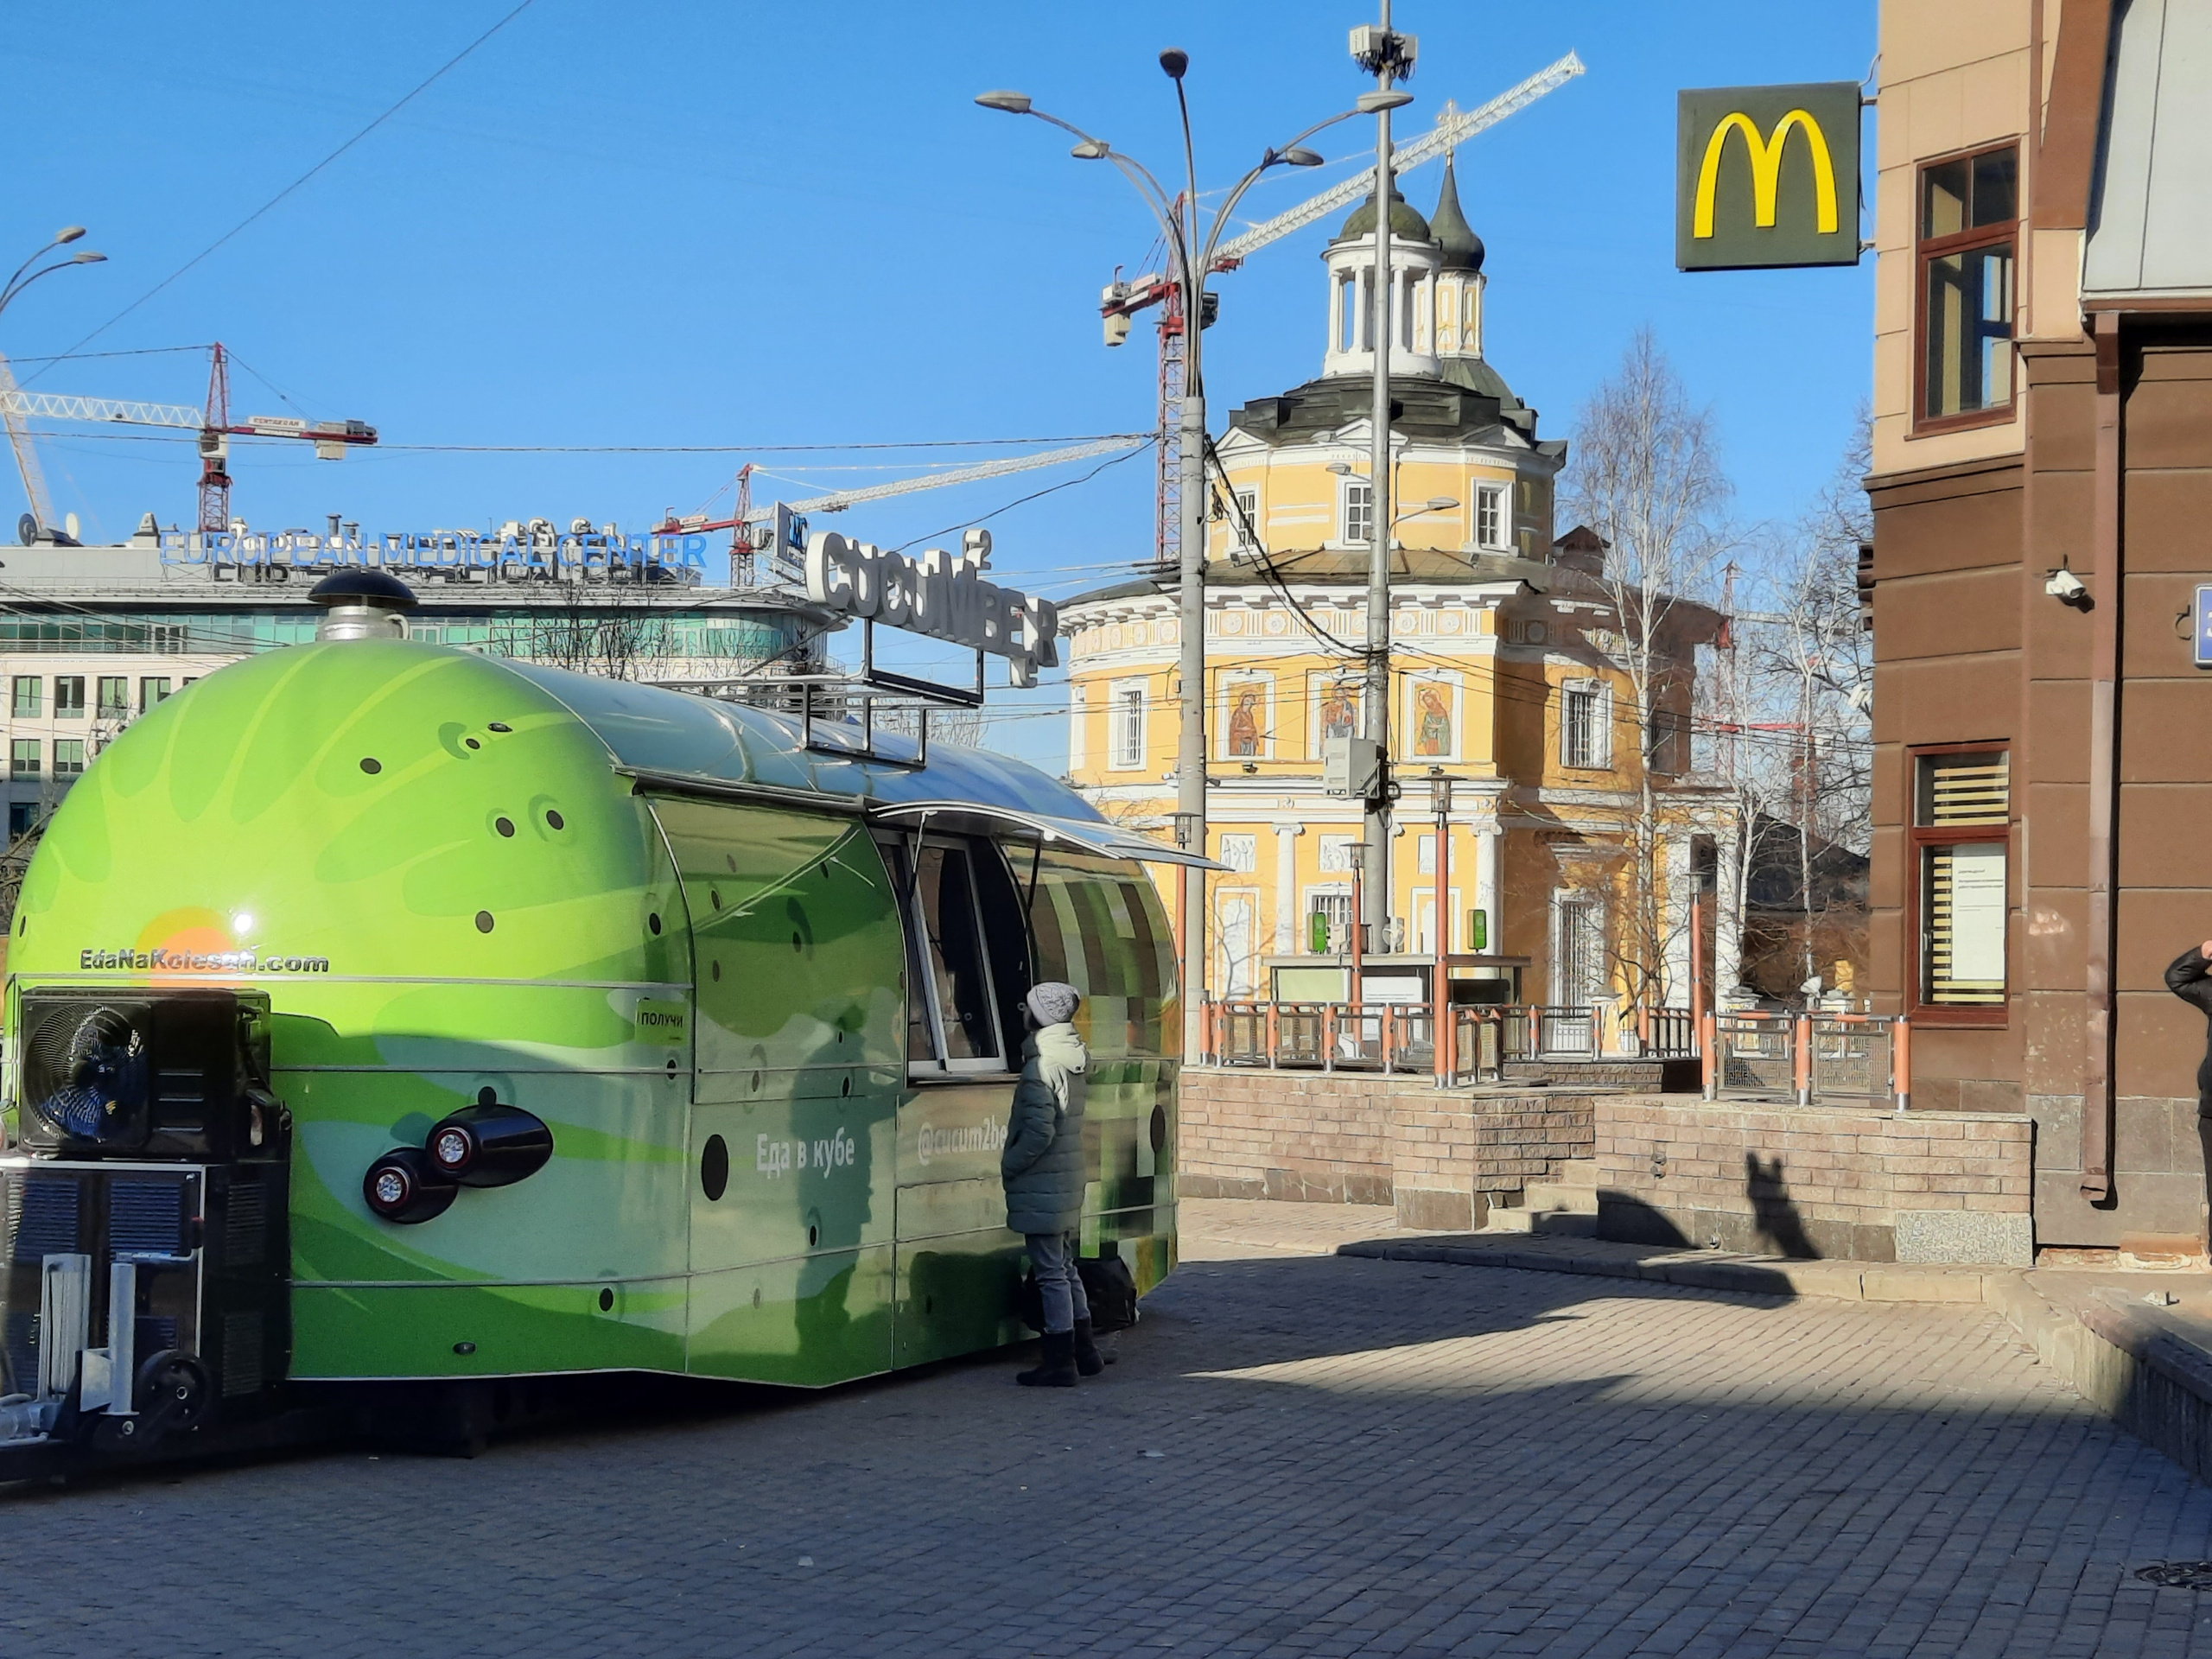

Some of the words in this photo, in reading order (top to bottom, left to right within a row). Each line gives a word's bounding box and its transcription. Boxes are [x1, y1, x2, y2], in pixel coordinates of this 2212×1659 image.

[159, 531, 369, 566] EUROPEAN
[379, 532, 549, 567] MEDICAL
[556, 532, 708, 569] CENTER
[756, 1133, 791, 1179] Еда
[797, 1140, 807, 1169] в
[813, 1126, 855, 1179] кубе
